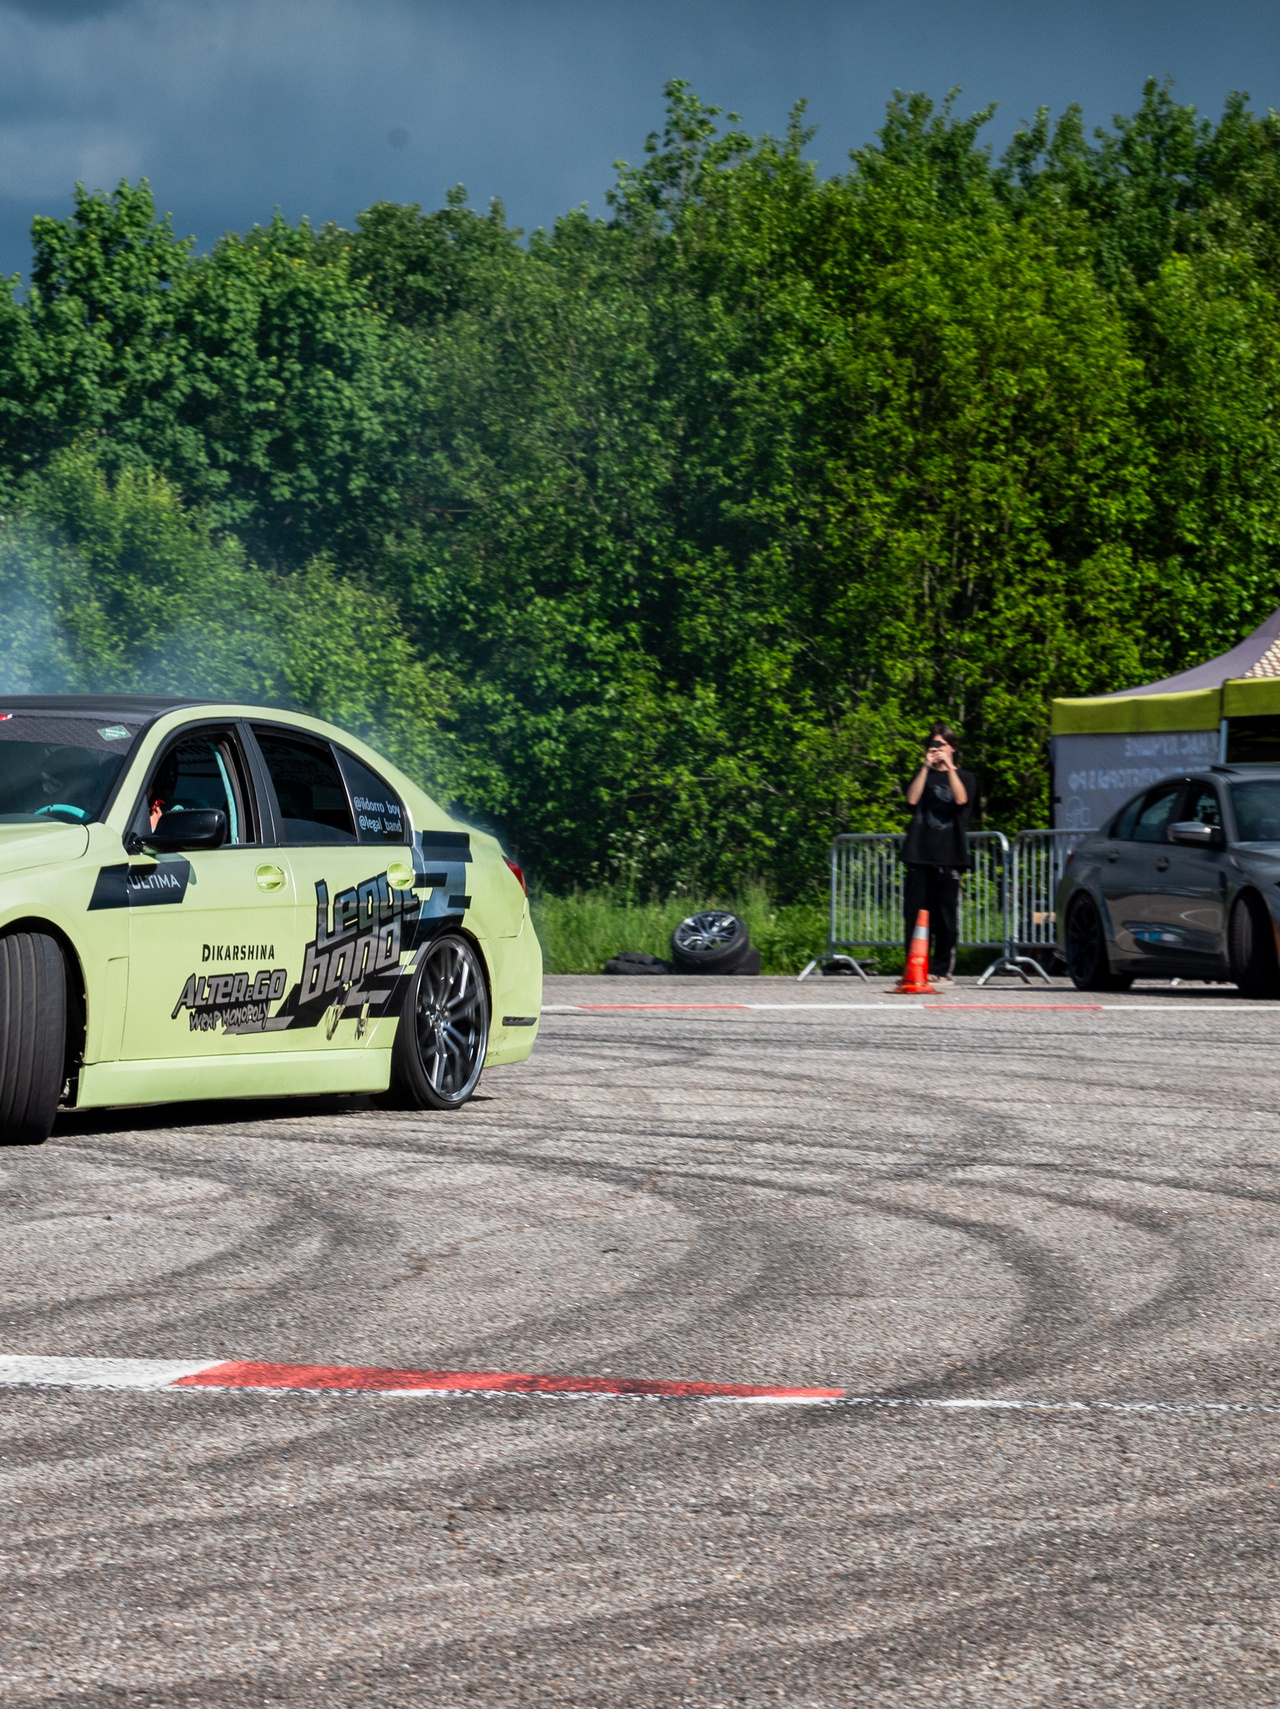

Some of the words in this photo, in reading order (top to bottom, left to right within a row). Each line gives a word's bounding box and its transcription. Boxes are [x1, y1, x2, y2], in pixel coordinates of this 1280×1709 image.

[128, 873, 181, 890] ULTIMA
[201, 943, 275, 962] DIKARSHINA
[189, 1010, 221, 1032] WRAP
[221, 1001, 271, 1030] MONOPOLY
